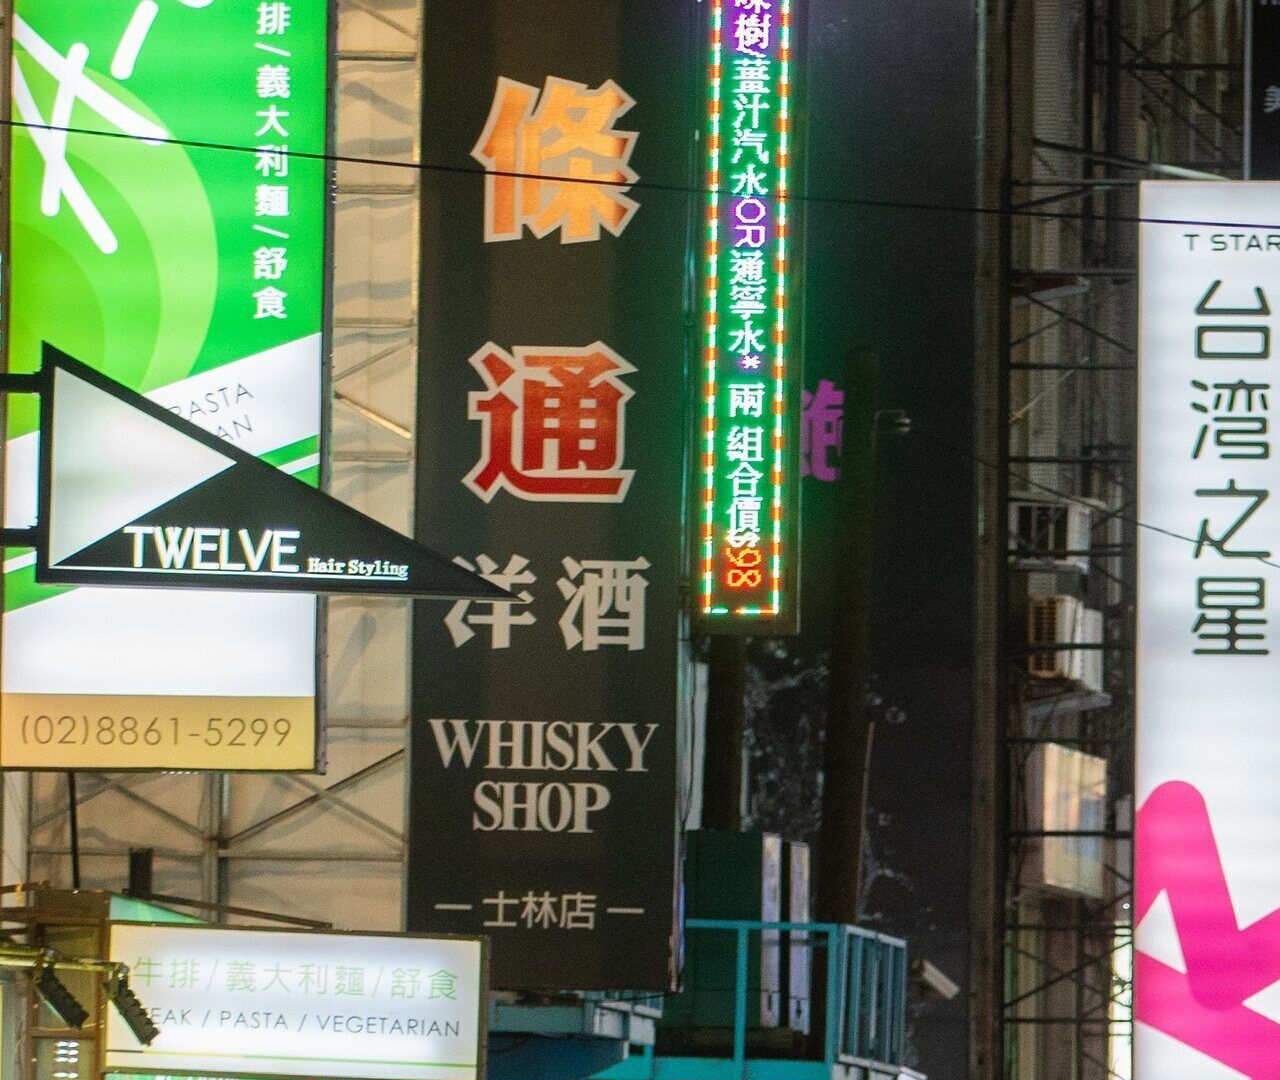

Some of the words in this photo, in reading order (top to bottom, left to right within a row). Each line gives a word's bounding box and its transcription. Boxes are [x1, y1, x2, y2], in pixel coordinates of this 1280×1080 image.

[1184, 234, 1199, 252] T
[462, 75, 641, 503] 條通
[123, 526, 300, 574] TWELVE
[308, 556, 344, 574] Hair
[347, 558, 409, 580] Styling
[443, 553, 652, 652] 洋酒
[20, 714, 293, 748] (02)8861-5299
[428, 718, 660, 773] WHISKY
[472, 781, 612, 834] SHOP
[482, 892, 597, 930] 士林店
[219, 1009, 289, 1030] PASTA
[315, 1013, 461, 1038] VEGETARIAN
